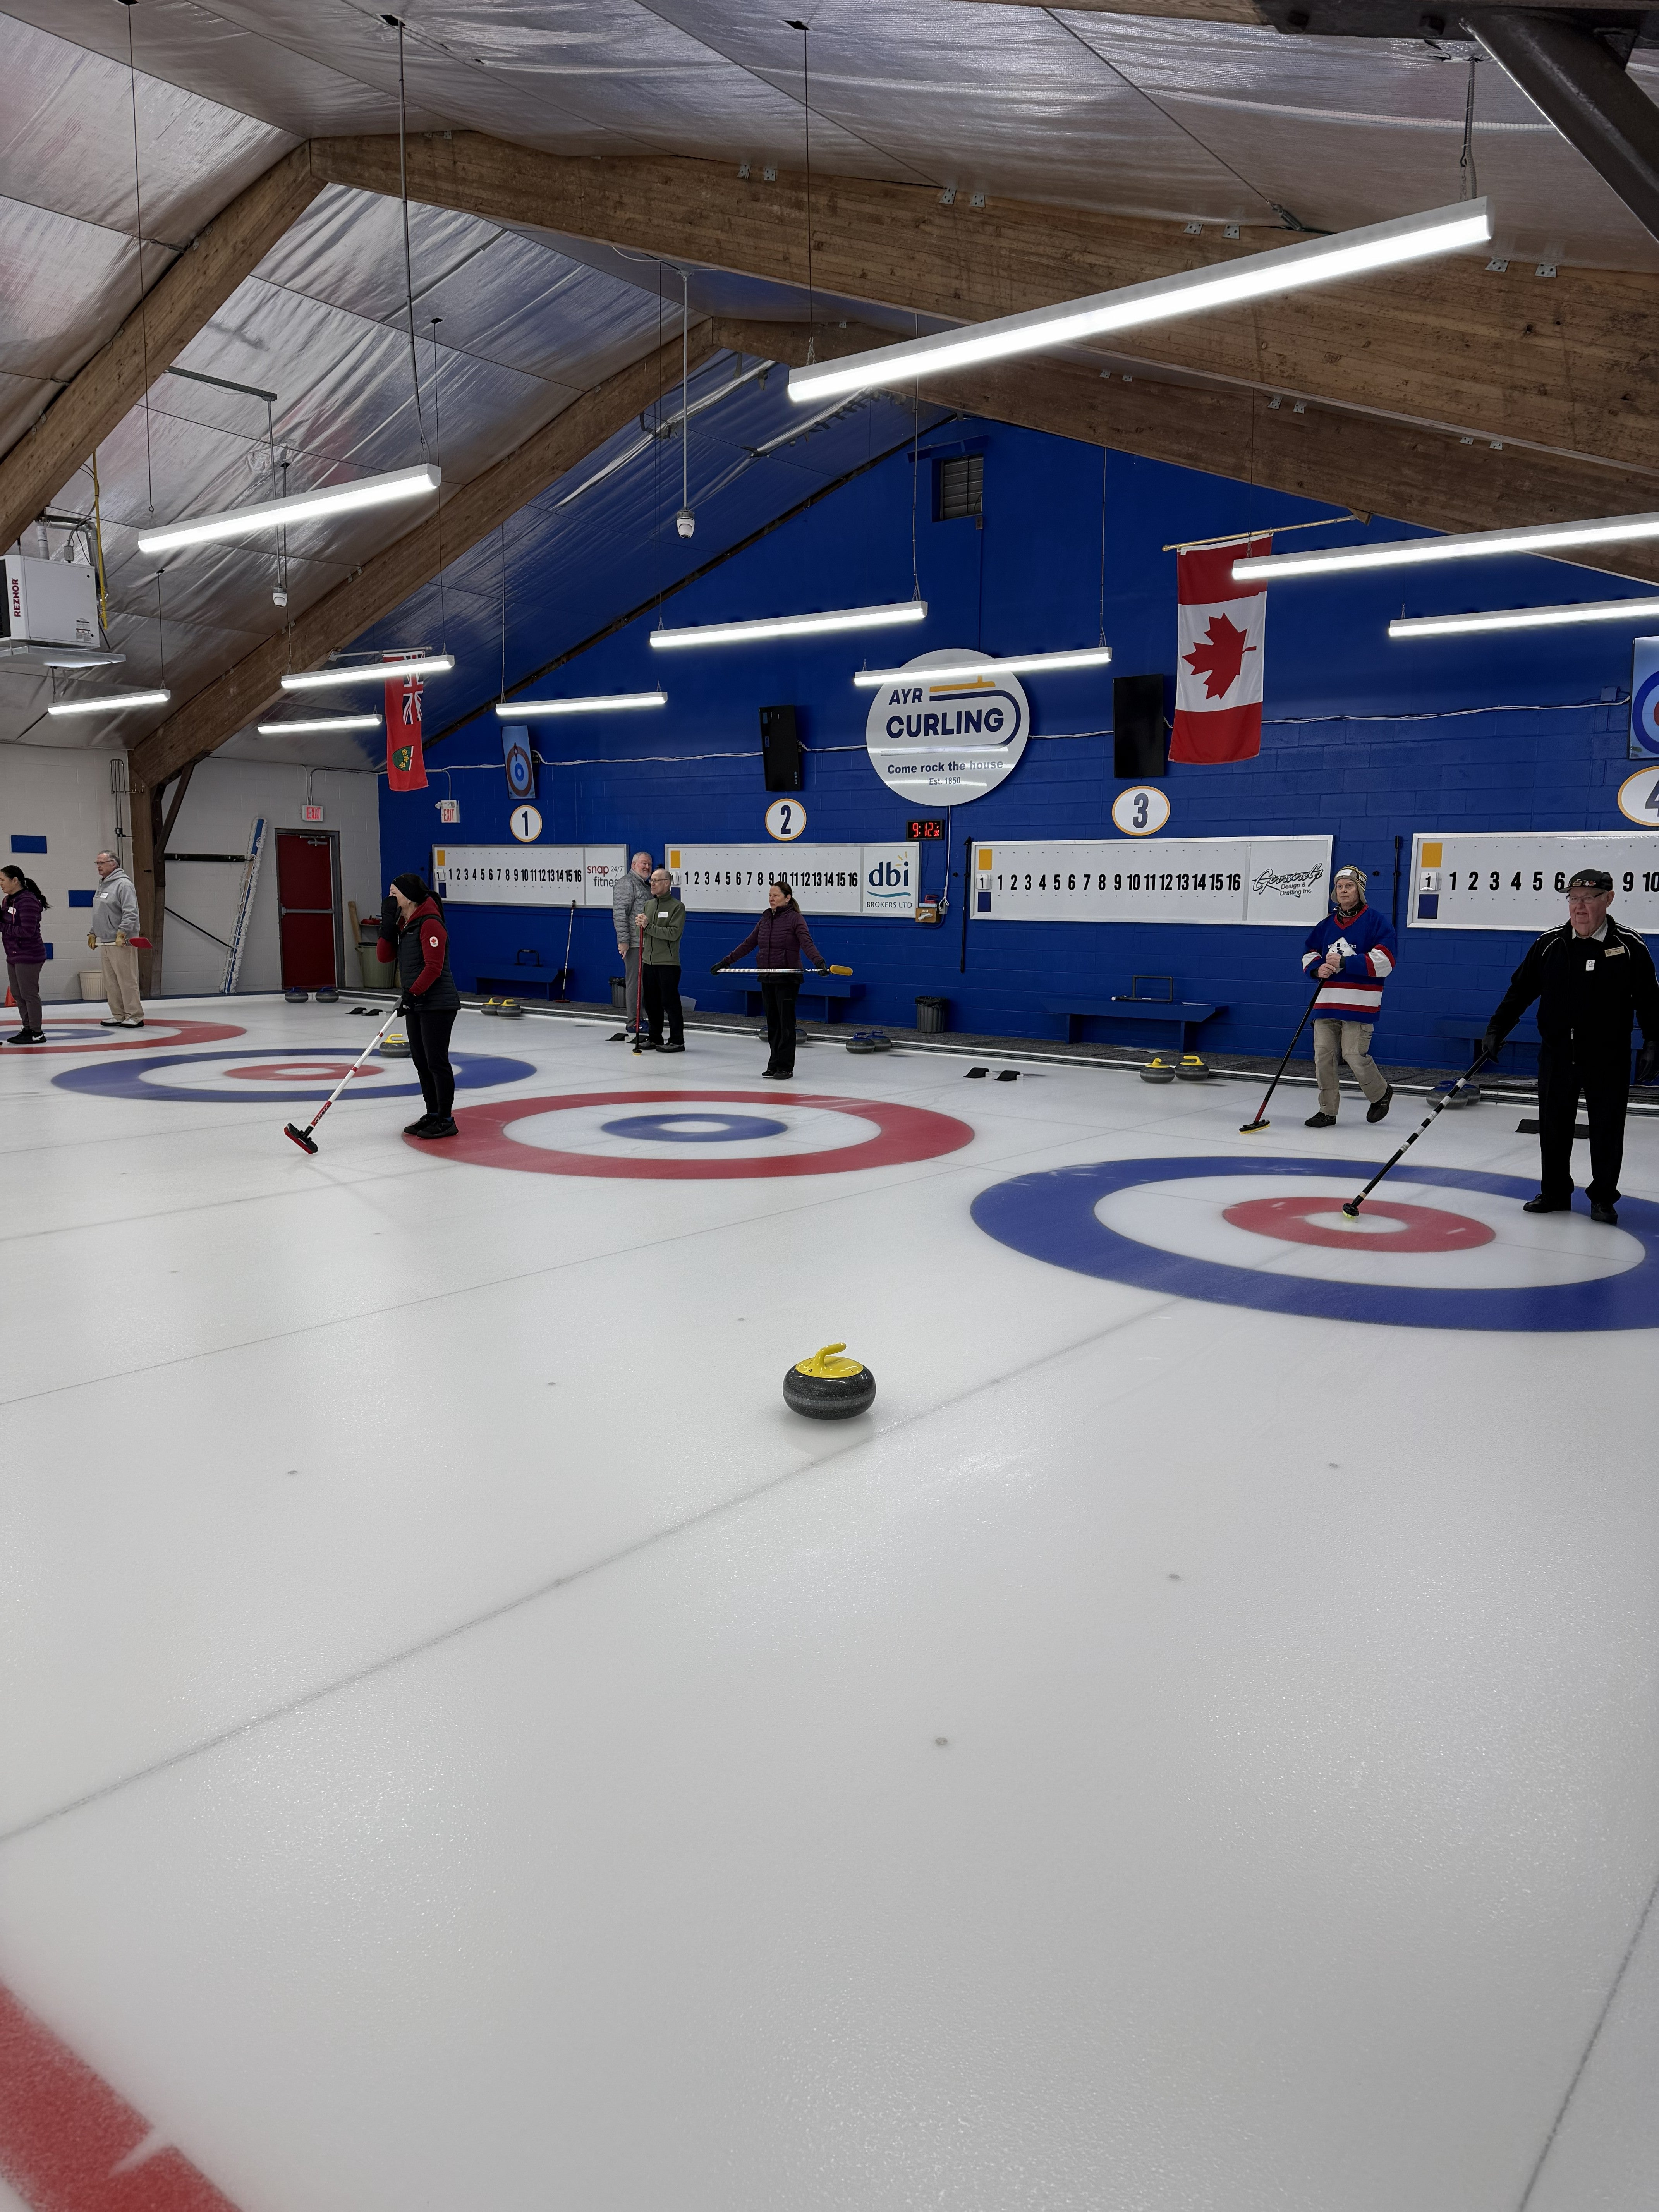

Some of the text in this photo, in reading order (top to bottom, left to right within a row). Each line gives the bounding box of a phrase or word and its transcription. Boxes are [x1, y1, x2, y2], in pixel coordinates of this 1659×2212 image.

[12, 579, 21, 617] REZNOR
[888, 687, 923, 705] AYR
[886, 708, 1004, 739] CURLING
[888, 760, 1003, 774] Come rock the house
[945, 776, 961, 785] 1850
[1645, 779, 1659, 817] 4
[307, 807, 321, 820] EXIT
[443, 809, 454, 821] EXIT
[1132, 793, 1149, 829] 3
[522, 811, 528, 836] 1
[780, 805, 791, 835] 2
[913, 822, 934, 837] 9:12
[448, 868, 582, 883] 1 2 3 4 5 6 7 8 9 10 11 12 13 14 15 16
[587, 866, 623, 878] snap 24/7
[684, 871, 858, 887] 1 2 3 4 5 6 7 8 9 10 11 12 13 14 15 16
[868, 861, 909, 886] dbi
[593, 876, 618, 887] fitne
[980, 877, 984, 888] 1
[997, 873, 1241, 891] 1 2 3 4 5 6 7 8 9 10 11 12 13 14 15 16
[1425, 876, 1431, 888] 1
[1449, 871, 1457, 890] 1
[1468, 871, 1479, 891] 2
[1489, 871, 1500, 891] 3
[1510, 871, 1522, 891] 4
[1532, 871, 1543, 891] 5
[1554, 871, 1565, 891] 6
[1623, 872, 1634, 892] 9
[1642, 871, 1659, 892] 10
[1280, 889, 1302, 898] Drafting
